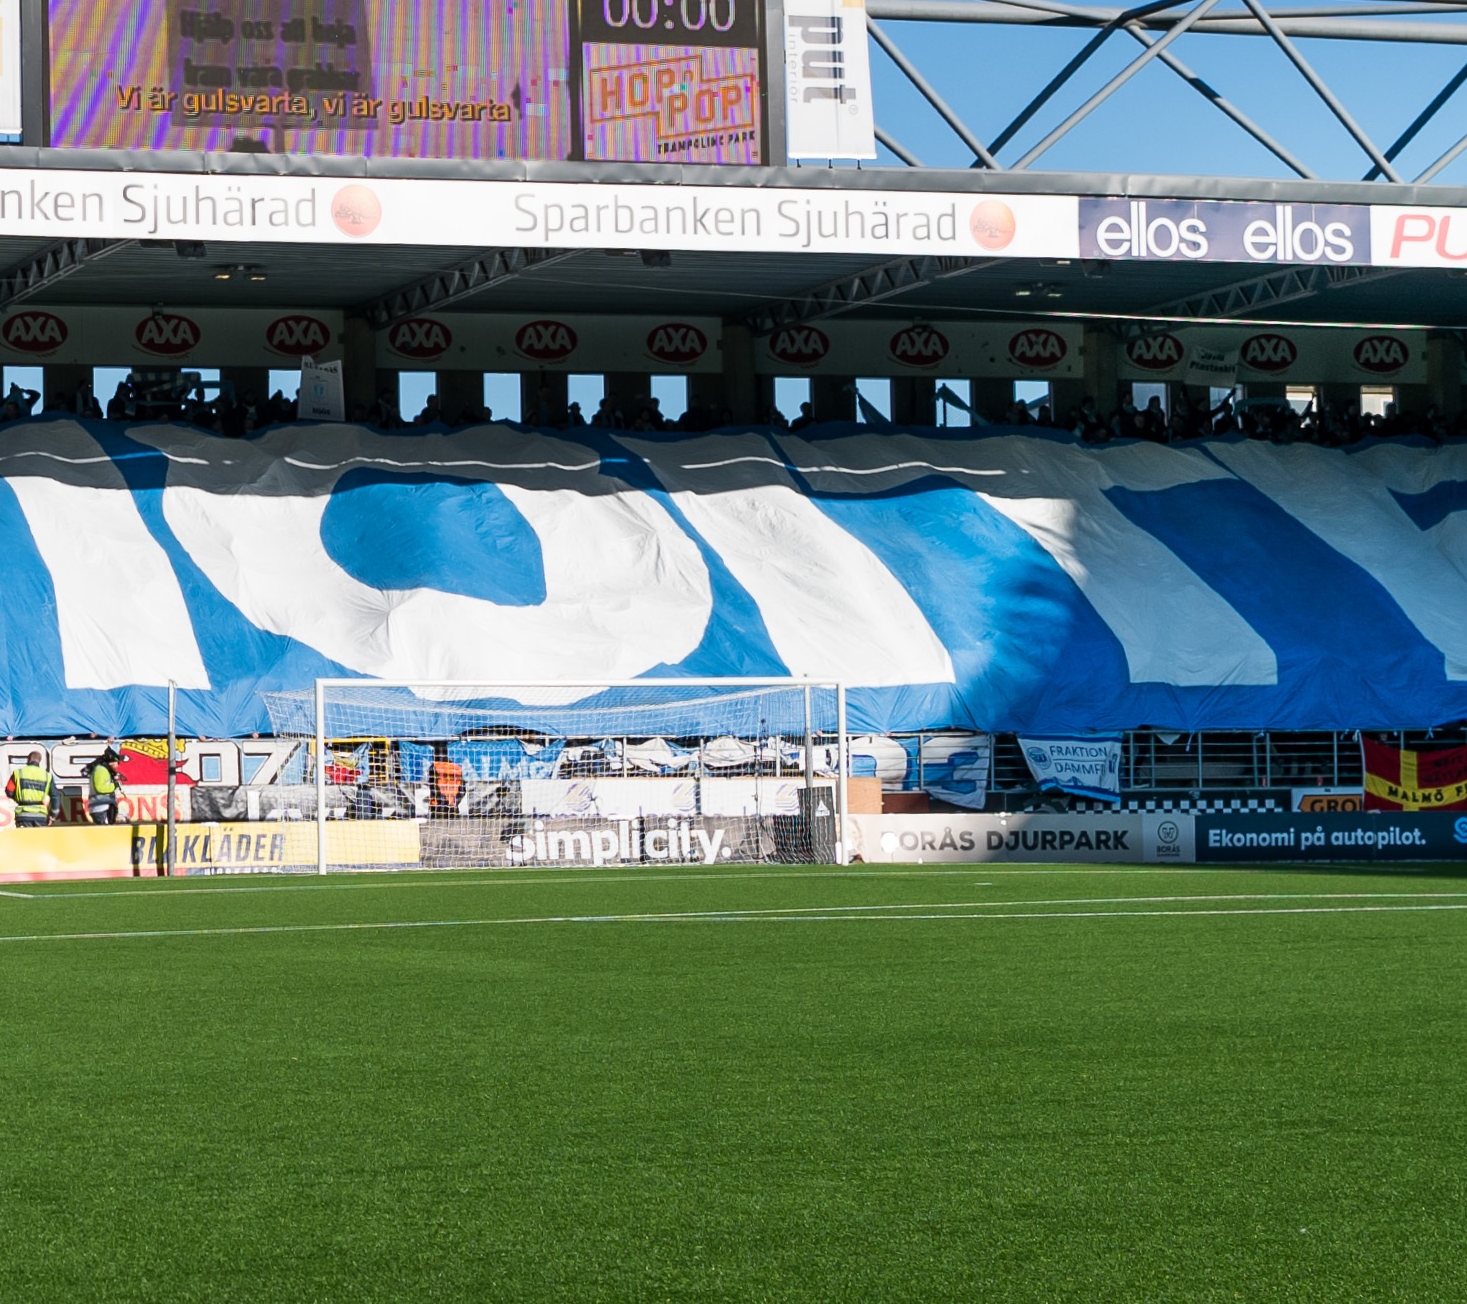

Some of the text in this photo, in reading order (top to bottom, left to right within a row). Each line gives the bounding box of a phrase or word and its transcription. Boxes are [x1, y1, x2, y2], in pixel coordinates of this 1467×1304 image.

[114, 83, 511, 124] Vi är gulsvarta, vi är gulsvarta
[601, 68, 675, 112] HOP
[668, 86, 742, 128] POP
[728, 130, 755, 145] PARK
[122, 183, 317, 233] Sjuhärad
[514, 194, 957, 248] Sparbanken Sjuhärad
[1096, 201, 1208, 258] ellos
[1243, 204, 1354, 262] ellos
[271, 320, 325, 346] AXA
[1014, 333, 1063, 358] AXA
[1049, 745, 1108, 758] FRAKTION
[1388, 785, 1444, 803] MALMÖ
[505, 818, 732, 865] simplicity.
[882, 825, 1130, 851] ORÅS DJURPARK
[1207, 825, 1427, 851] Ekonomi på autopilot.
